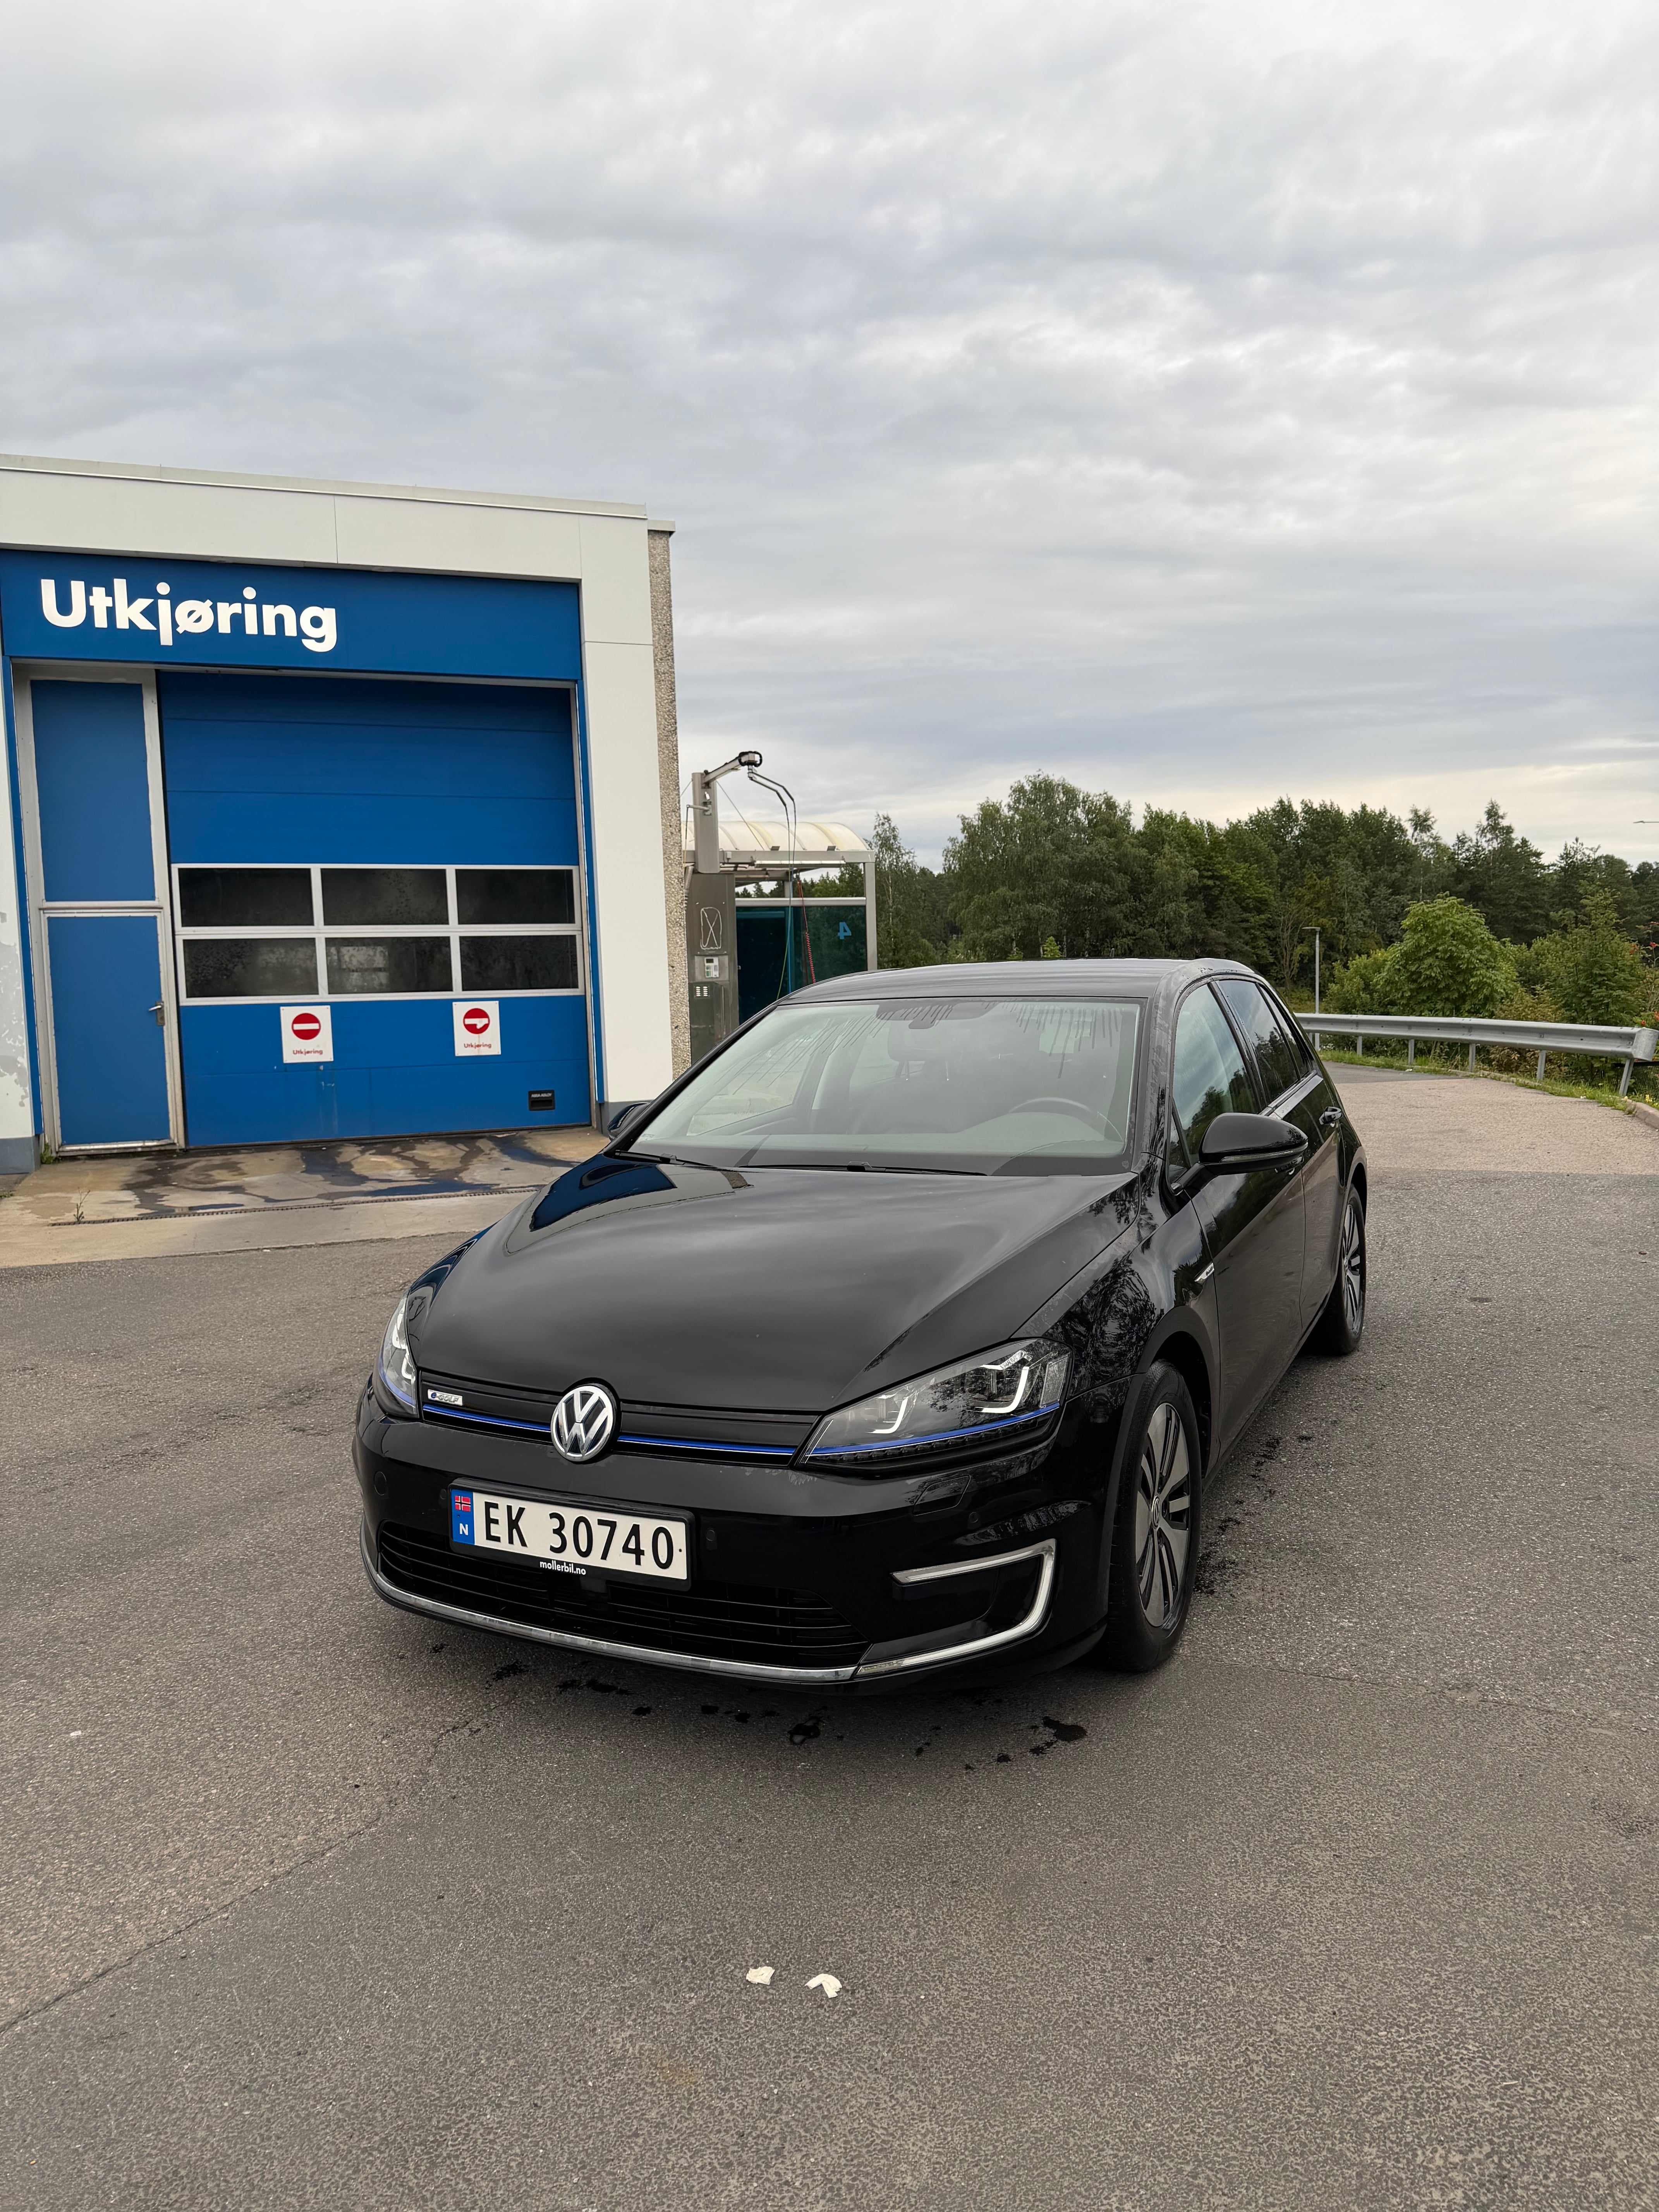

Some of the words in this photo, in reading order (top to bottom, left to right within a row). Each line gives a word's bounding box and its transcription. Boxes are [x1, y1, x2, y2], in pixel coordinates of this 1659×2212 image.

[41, 579, 337, 652] Utkjøring
[460, 1523, 468, 1535] N
[484, 1501, 528, 1547] EK
[549, 1512, 674, 1569] 30740
[539, 1560, 586, 1575] mollerbil.no
